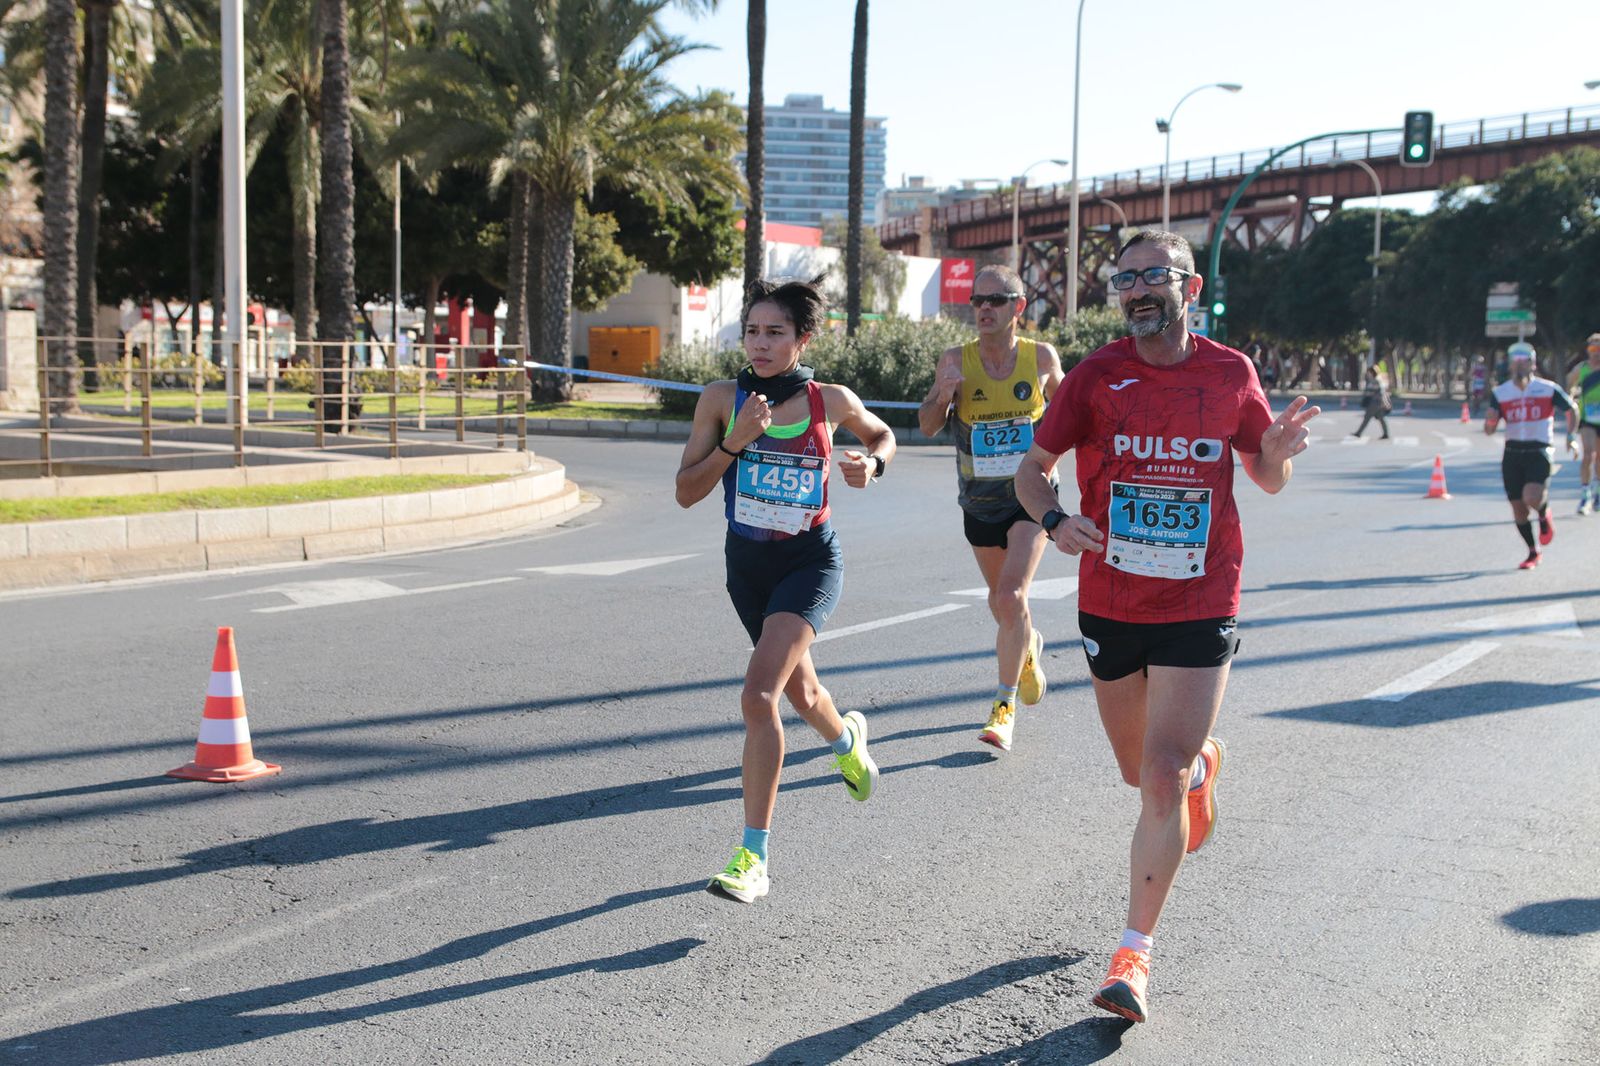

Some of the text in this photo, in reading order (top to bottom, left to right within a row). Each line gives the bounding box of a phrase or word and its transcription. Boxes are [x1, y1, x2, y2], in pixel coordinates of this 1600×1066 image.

[984, 428, 1021, 447] 622
[1114, 434, 1223, 462] PULSO
[747, 464, 815, 494] 1459
[1147, 464, 1195, 475] RUNNING
[756, 488, 781, 497] HASNA
[1122, 499, 1201, 531] 1653
[1128, 525, 1189, 539] JOSE ANTONIO
